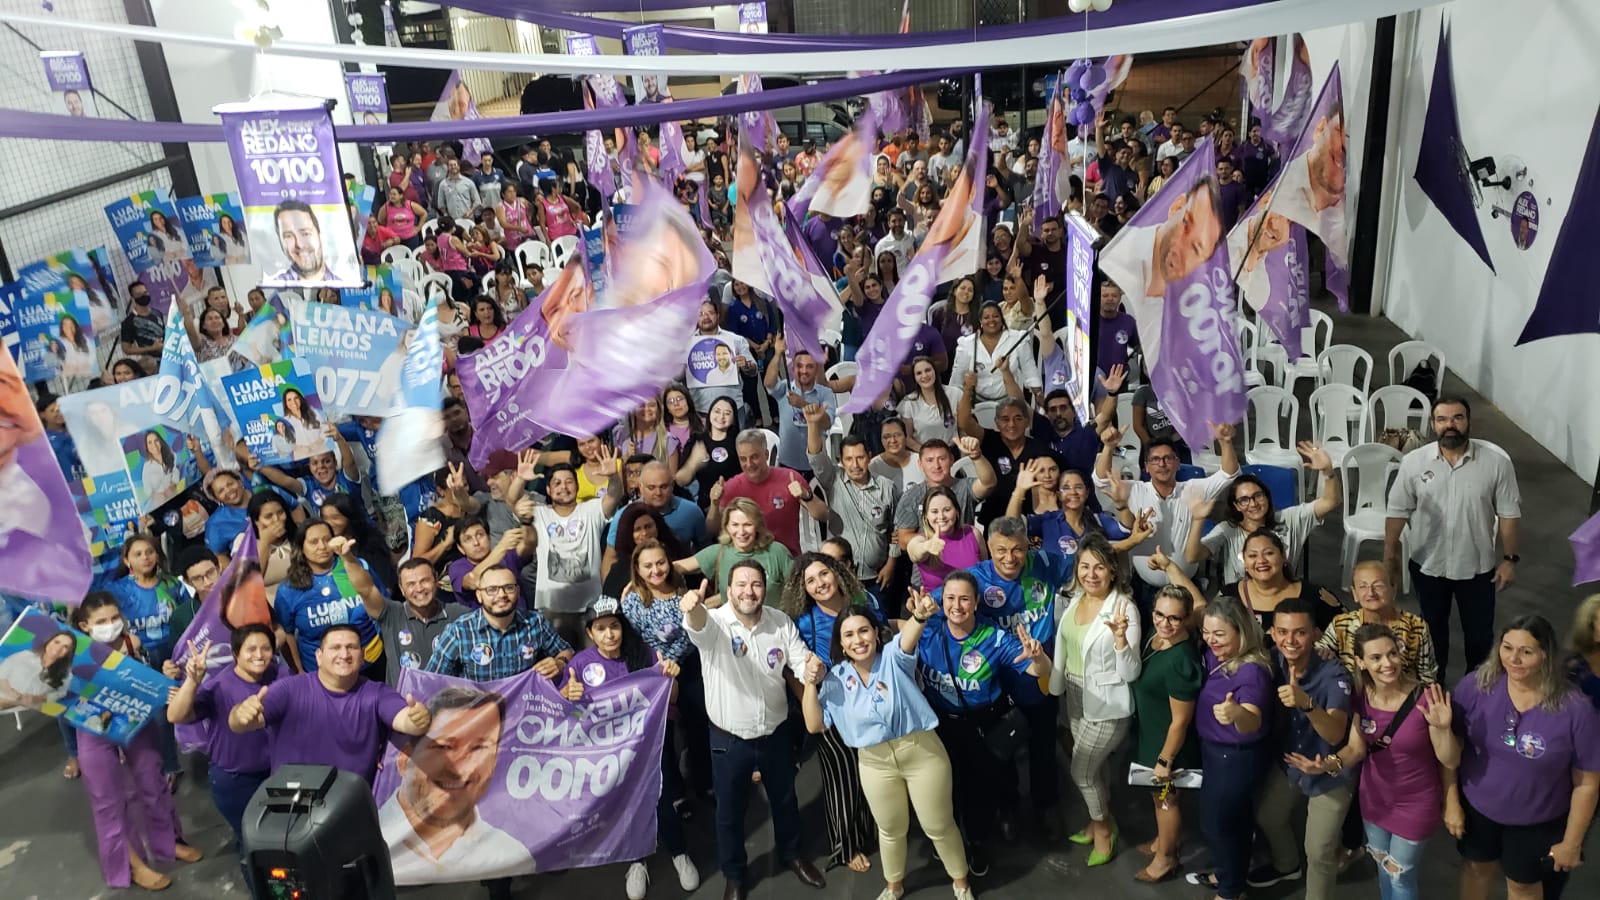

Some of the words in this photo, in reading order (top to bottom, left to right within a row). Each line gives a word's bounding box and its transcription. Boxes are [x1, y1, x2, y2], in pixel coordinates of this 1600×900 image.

[355, 94, 381, 106] 10100
[242, 119, 281, 136] ALEX
[242, 133, 318, 154] REDANO
[250, 156, 325, 185] 10100
[111, 200, 152, 221] LUANA
[182, 202, 222, 219] LUANA
[299, 302, 398, 337] LUANA
[296, 326, 373, 352] LEMOS
[475, 330, 522, 371] ALEX
[230, 374, 286, 396] LUANA
[234, 388, 276, 406] LEMOS
[244, 432, 274, 446] 1077
[307, 594, 364, 619] LUANA
[1000, 606, 1048, 629] UANA
[922, 663, 981, 691] LUANA
[93, 694, 149, 721] LEMOS
[100, 686, 152, 714] LUANA
